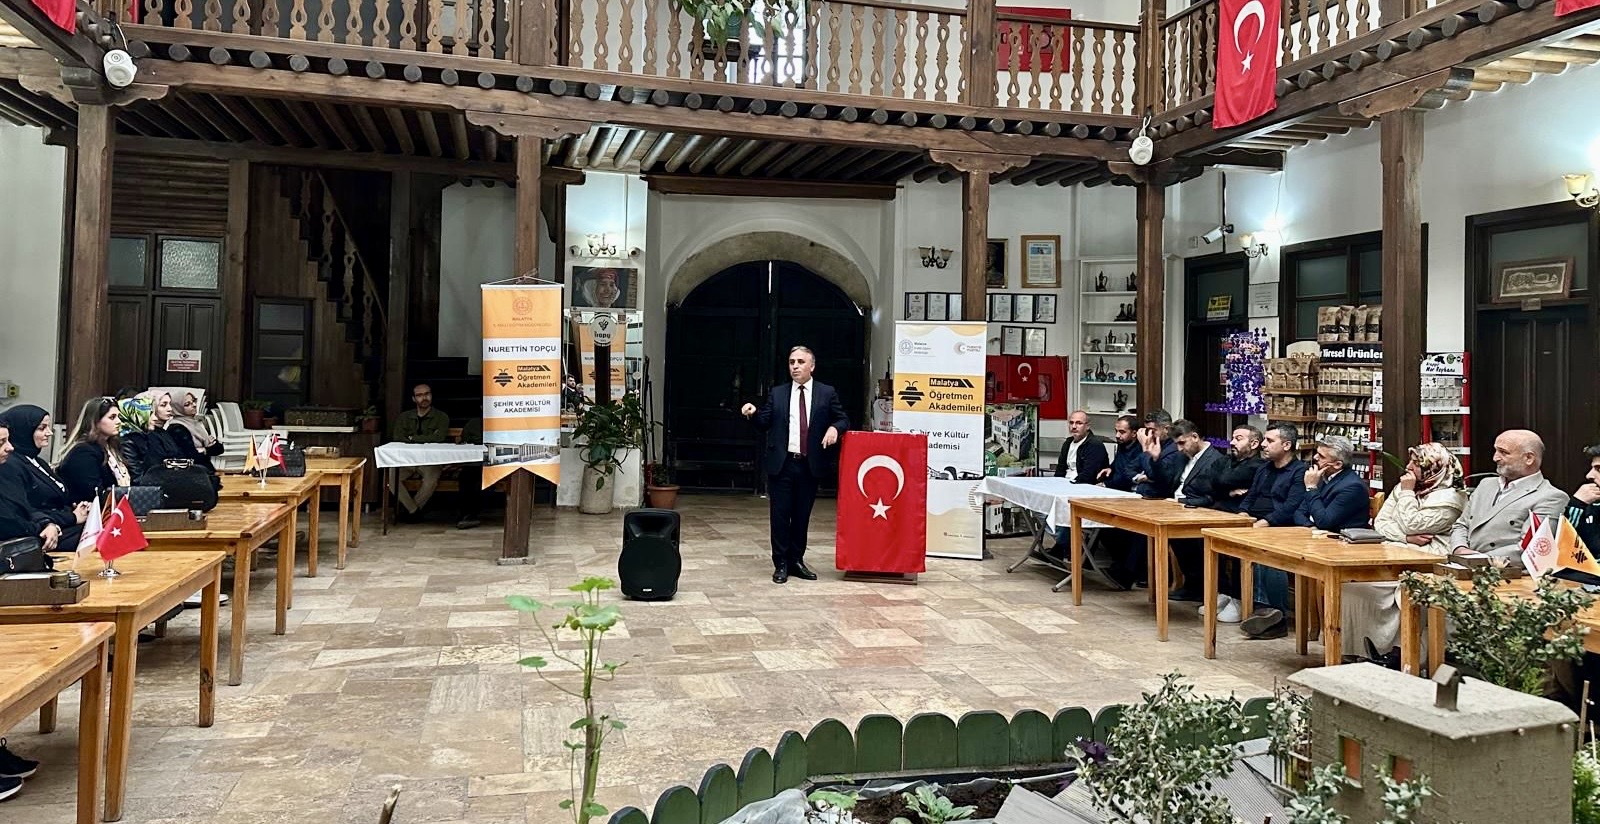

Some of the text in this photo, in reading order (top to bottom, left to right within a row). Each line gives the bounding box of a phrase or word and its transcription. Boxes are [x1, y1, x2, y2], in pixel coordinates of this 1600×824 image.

[488, 345, 557, 353] NURETTİN TOPÇU
[517, 373, 551, 381] Öğretmen
[930, 379, 959, 388] Malatya
[929, 390, 973, 401] Öğretmen
[493, 401, 513, 409] ŞEHİR
[929, 402, 982, 412] Akademileri
[944, 430, 970, 439] Kültür
[928, 442, 960, 450] ademisi
